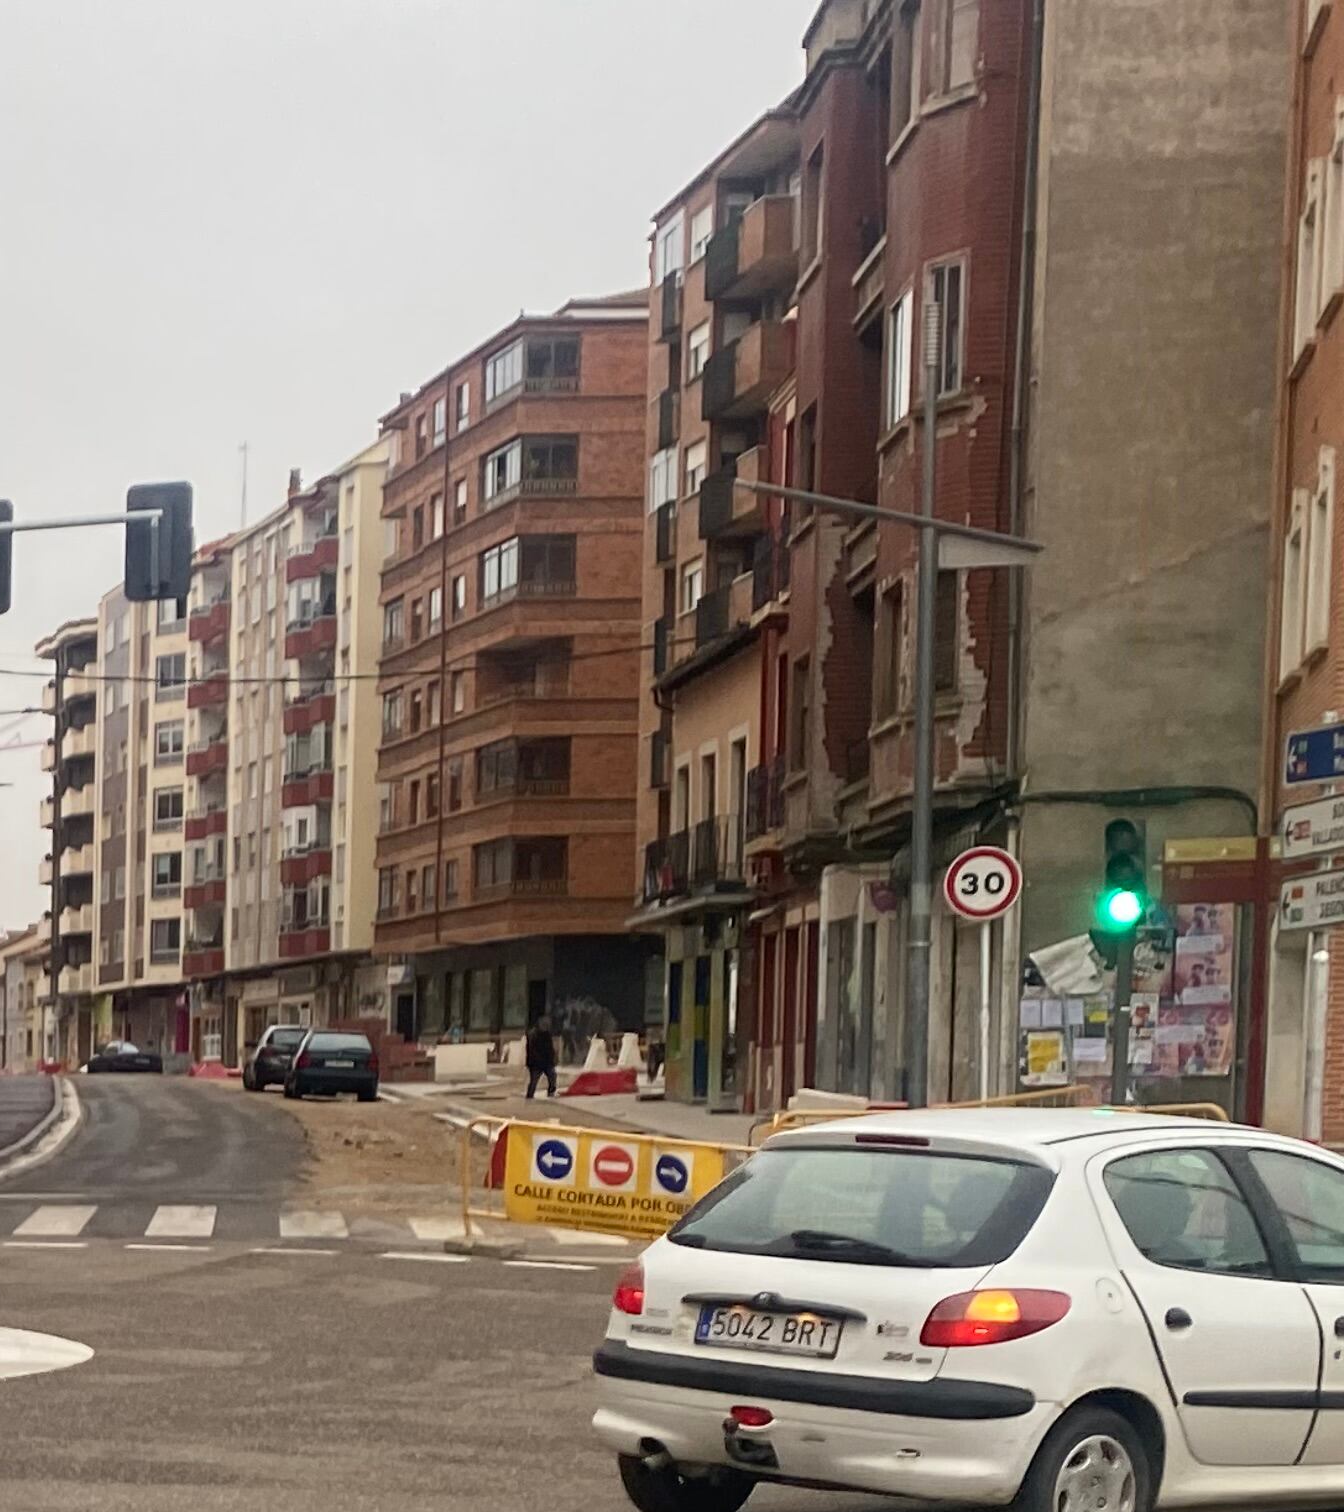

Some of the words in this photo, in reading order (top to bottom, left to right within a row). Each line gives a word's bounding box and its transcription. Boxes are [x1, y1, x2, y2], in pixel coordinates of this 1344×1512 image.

[961, 871, 1005, 895] 30
[514, 1184, 552, 1200] CALLE
[558, 1190, 626, 1209] CORTADA
[631, 1198, 661, 1213] POR
[712, 1311, 773, 1343] 5042
[782, 1318, 837, 1349] BRT
